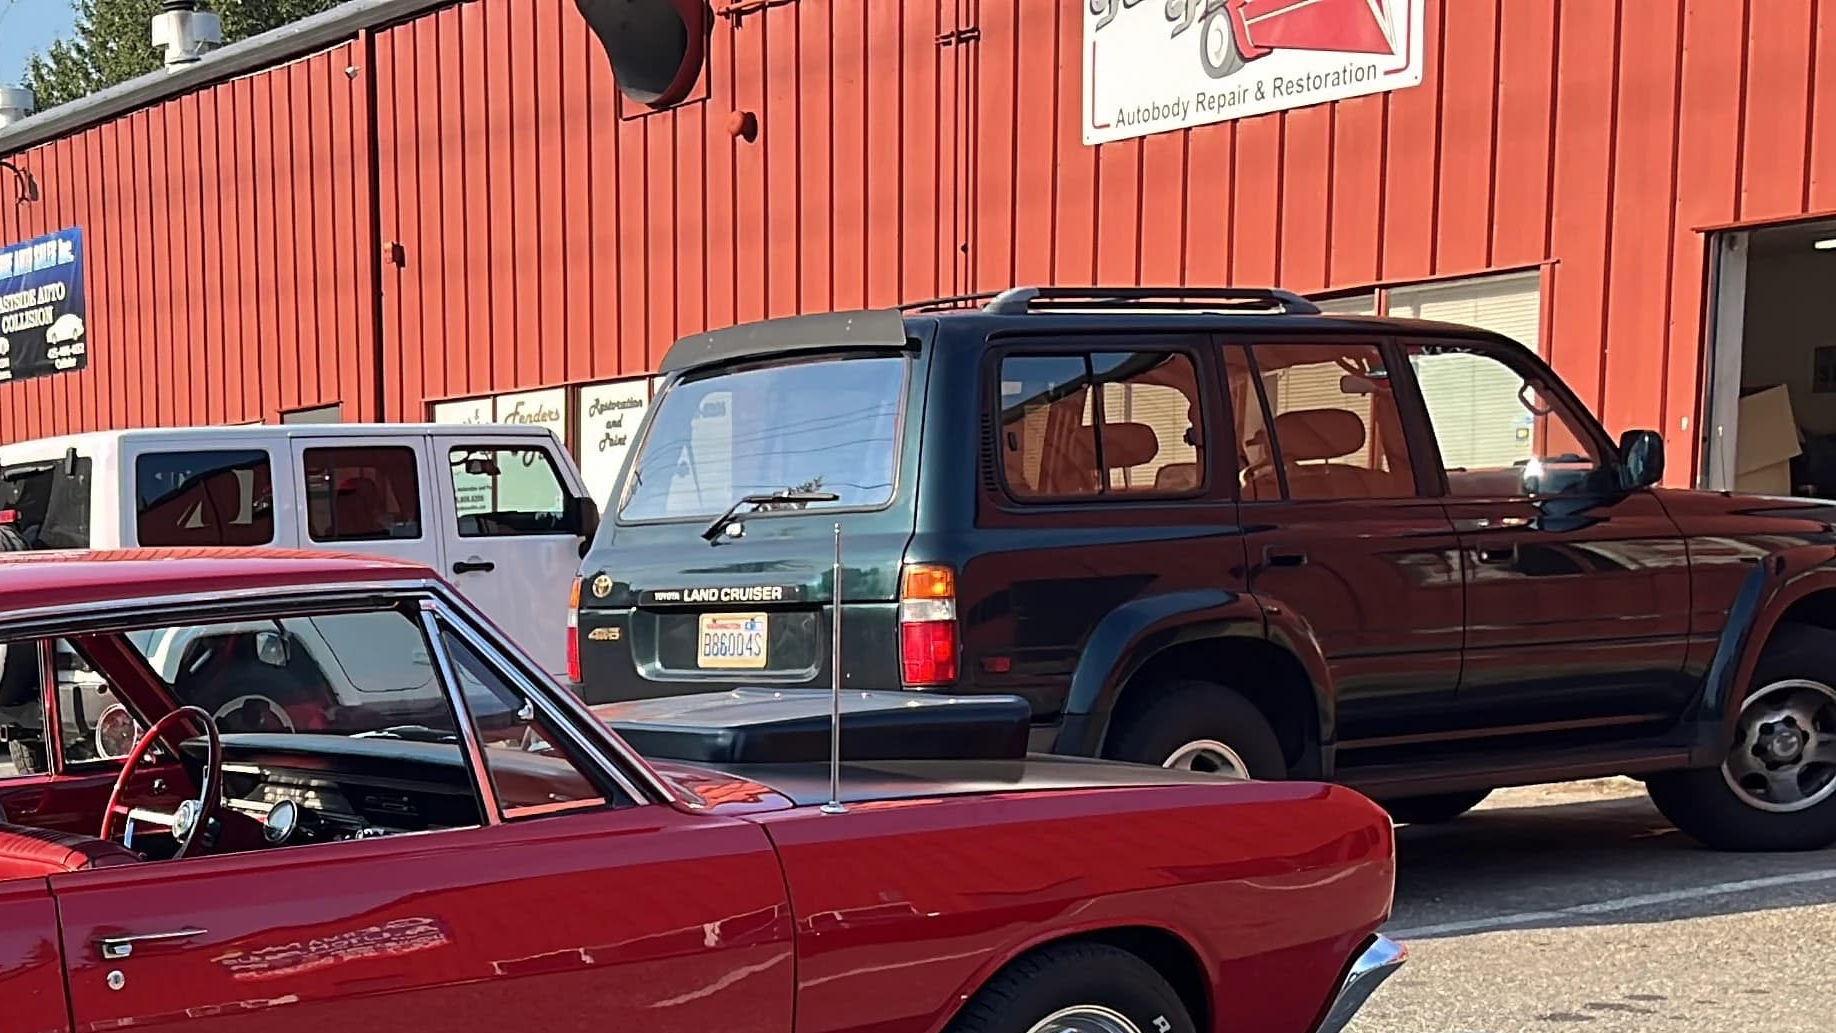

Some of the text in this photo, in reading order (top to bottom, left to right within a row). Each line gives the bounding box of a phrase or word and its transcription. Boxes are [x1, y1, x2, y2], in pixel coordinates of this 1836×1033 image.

[1115, 62, 1378, 129] Autobody Repair & Restoration
[37, 281, 66, 305] AUTO
[1, 305, 54, 334] COLLISION
[504, 400, 560, 424] Fenders
[589, 396, 643, 418] Restoration
[605, 413, 624, 429] and
[598, 432, 627, 453] Paint
[654, 586, 783, 602] TOYOTA LAND CRUISER
